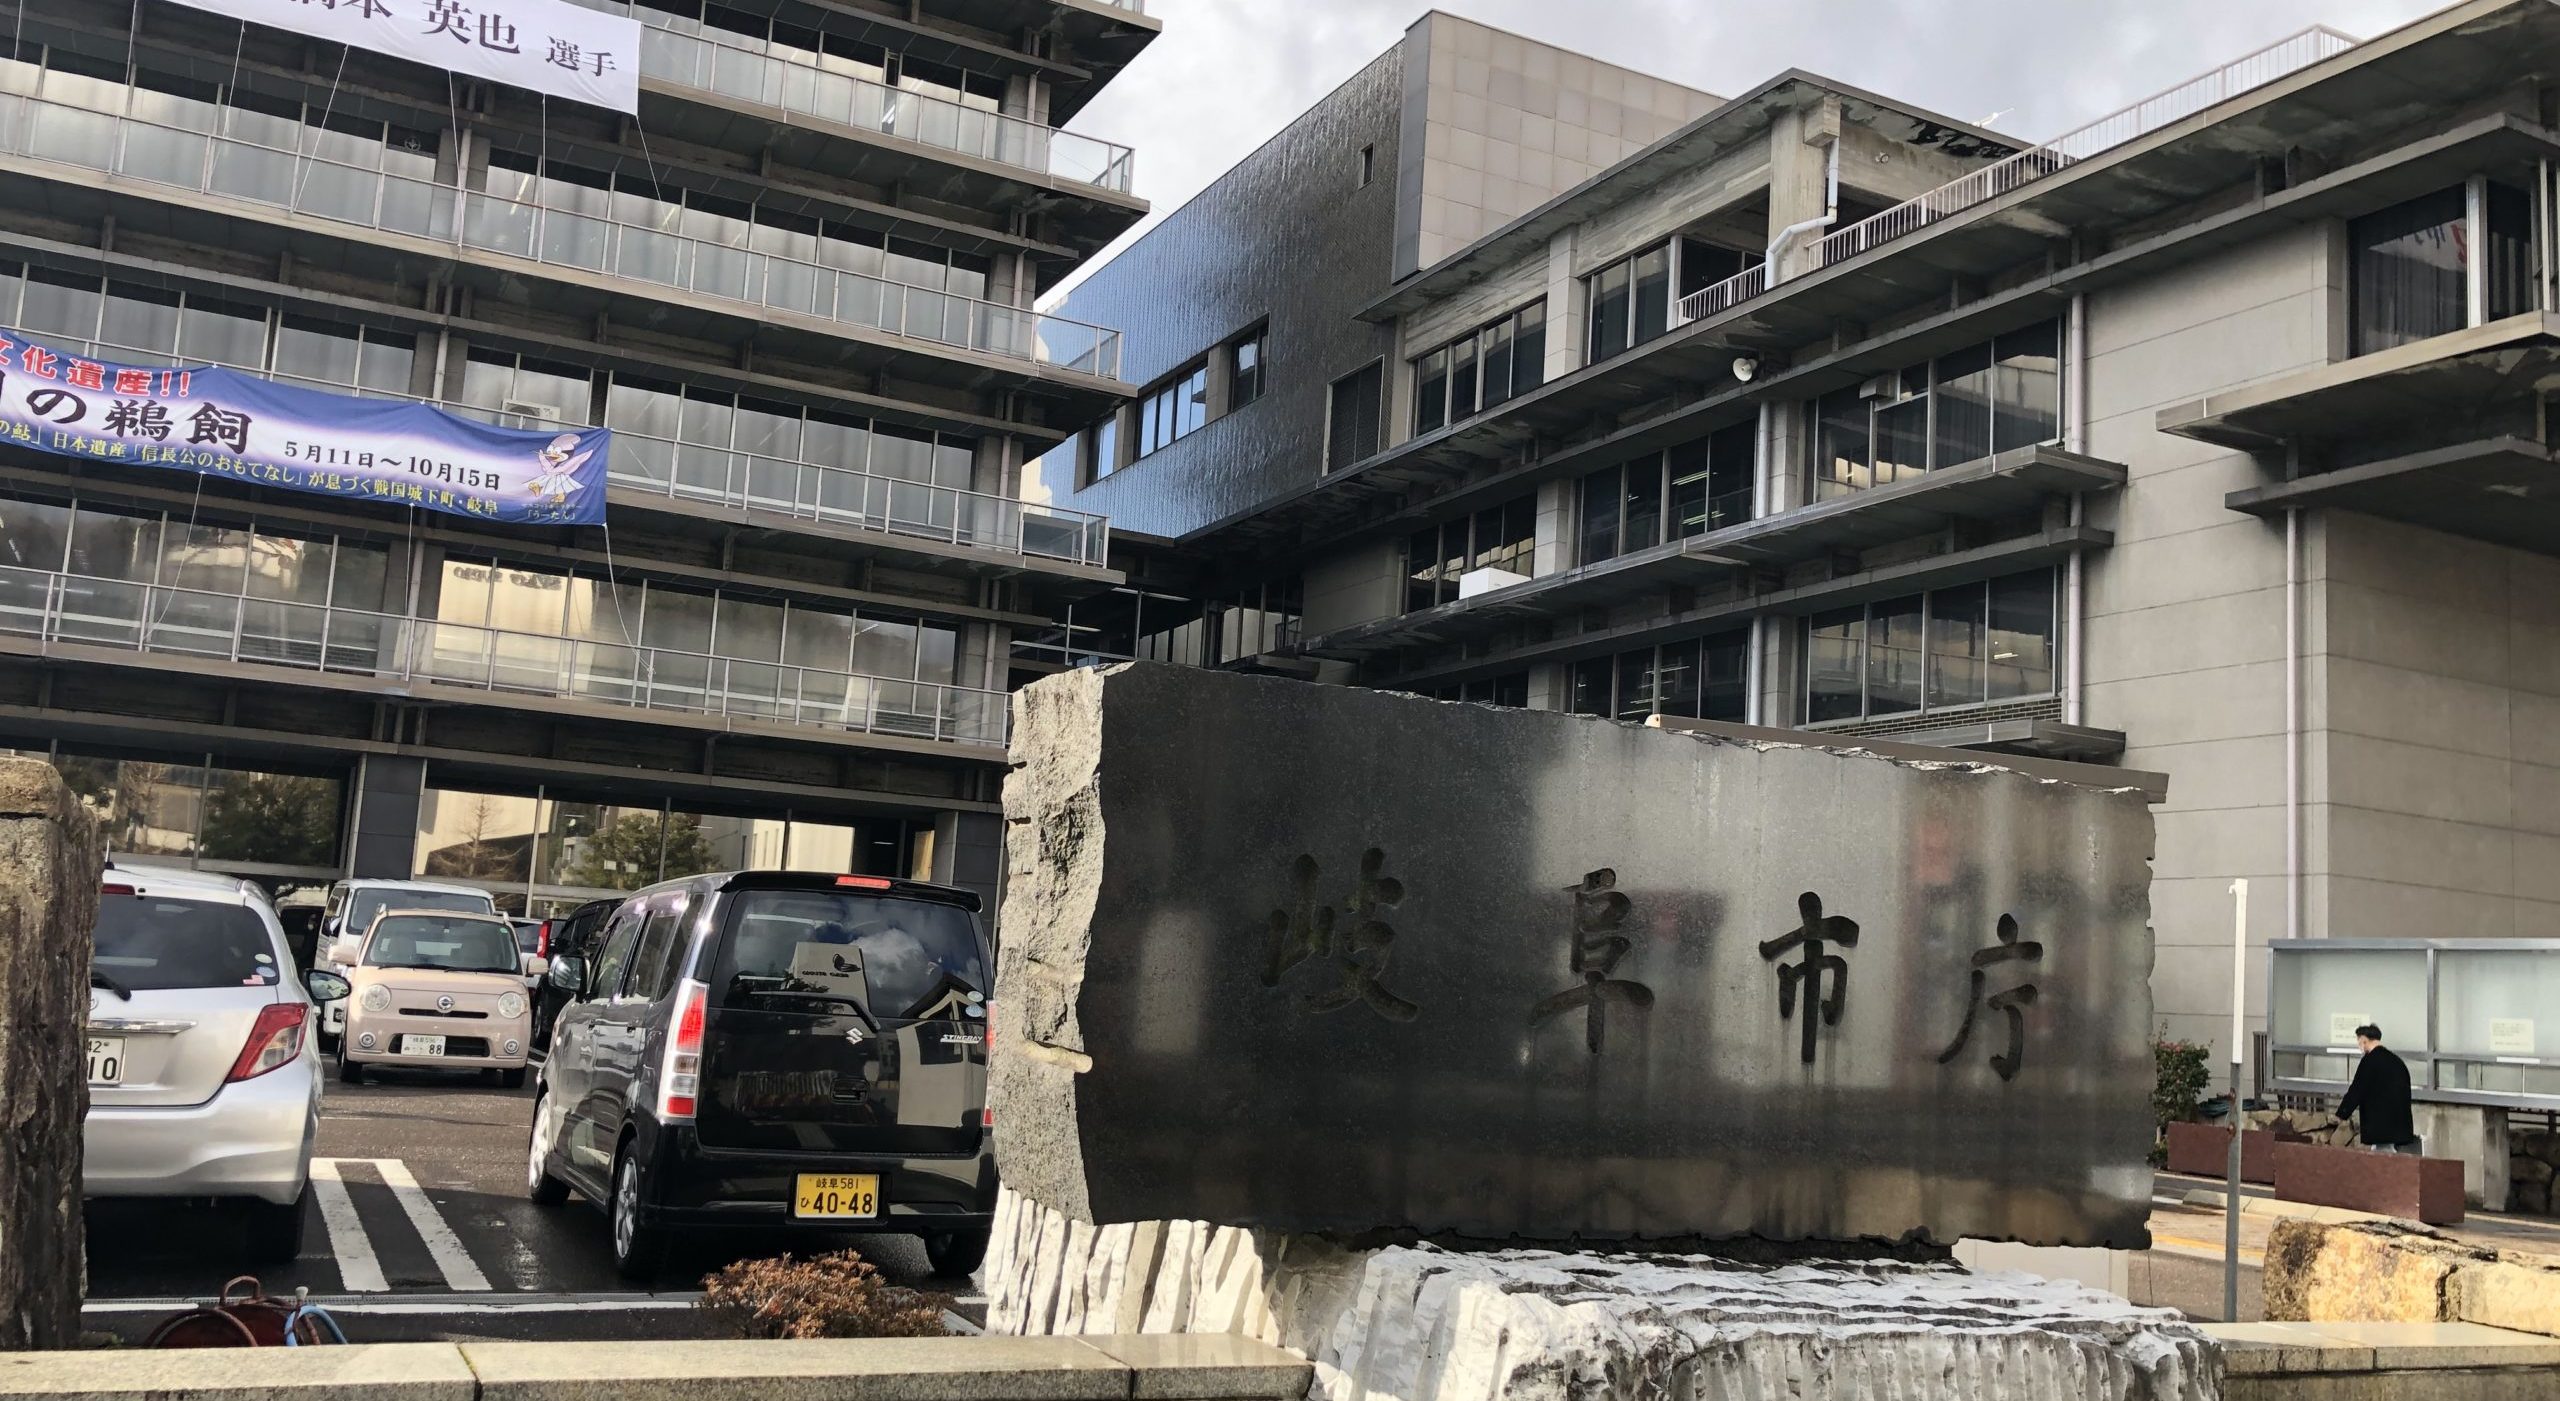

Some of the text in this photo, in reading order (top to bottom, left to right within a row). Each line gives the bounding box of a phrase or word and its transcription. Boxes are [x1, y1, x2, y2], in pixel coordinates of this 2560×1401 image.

[422, 2, 520, 54] 英也
[546, 36, 616, 77] 選手
[0, 369, 253, 455] の鵜飼
[1259, 847, 2044, 1083] 岐阜市庁
[941, 1034, 983, 1043] STINGRAY
[813, 1191, 873, 1215] 40-48
